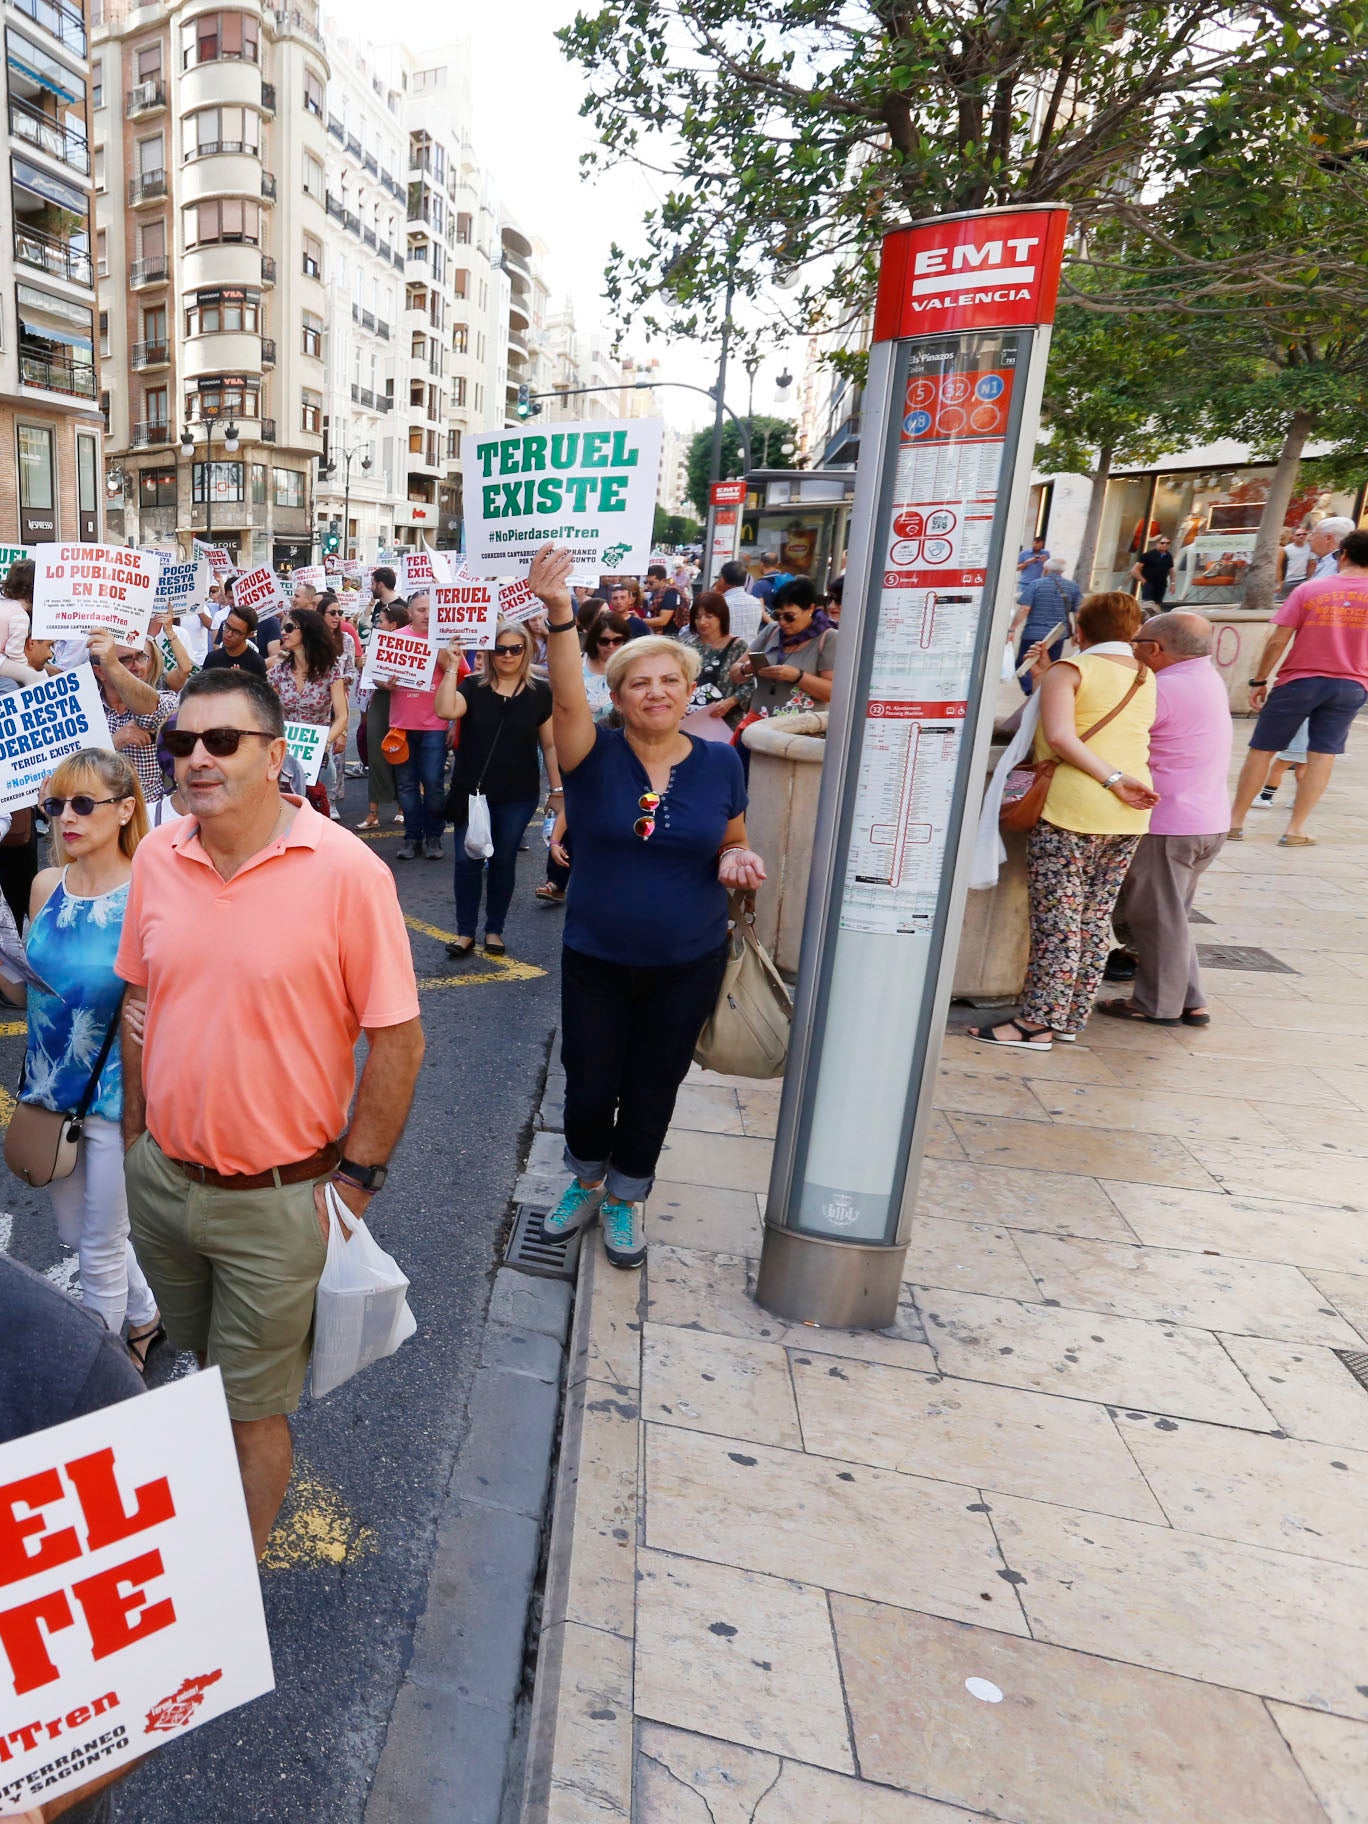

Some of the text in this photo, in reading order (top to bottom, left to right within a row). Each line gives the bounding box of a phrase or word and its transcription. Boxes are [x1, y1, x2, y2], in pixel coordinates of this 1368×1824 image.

[913, 237, 1039, 276] EMT
[911, 288, 1031, 312] VALENCIA
[916, 380, 998, 401] 5 32 N1
[477, 430, 640, 478] TERUEL
[482, 475, 630, 520] EXISTE
[28, 519, 53, 530] NESPRESSO
[489, 526, 599, 543] #NoPierdaselTren
[163, 563, 198, 576] POCOS
[406, 555, 429, 567] TER
[45, 564, 150, 589] LO PUBLICADO
[158, 573, 194, 586] RESTA
[235, 567, 271, 596] TERUEL
[407, 567, 432, 578] EXIS
[888, 574, 895, 584] 5
[72, 582, 126, 601] EN BOE
[237, 581, 276, 607] EXISTE
[436, 587, 491, 605] TERUEL
[500, 590, 536, 612] EXIST
[55, 611, 128, 626] #NoPierdaselTren
[437, 606, 488, 623] EXISTE
[377, 634, 432, 657] TERUEL
[376, 648, 427, 671] EXISTE
[21, 672, 80, 710] POCOS
[21, 695, 82, 732] RESTA
[871, 705, 882, 714] 32
[11, 740, 82, 771] TERUEL EXISTE
[8, 1736, 130, 1805] Y SAGUNTO
